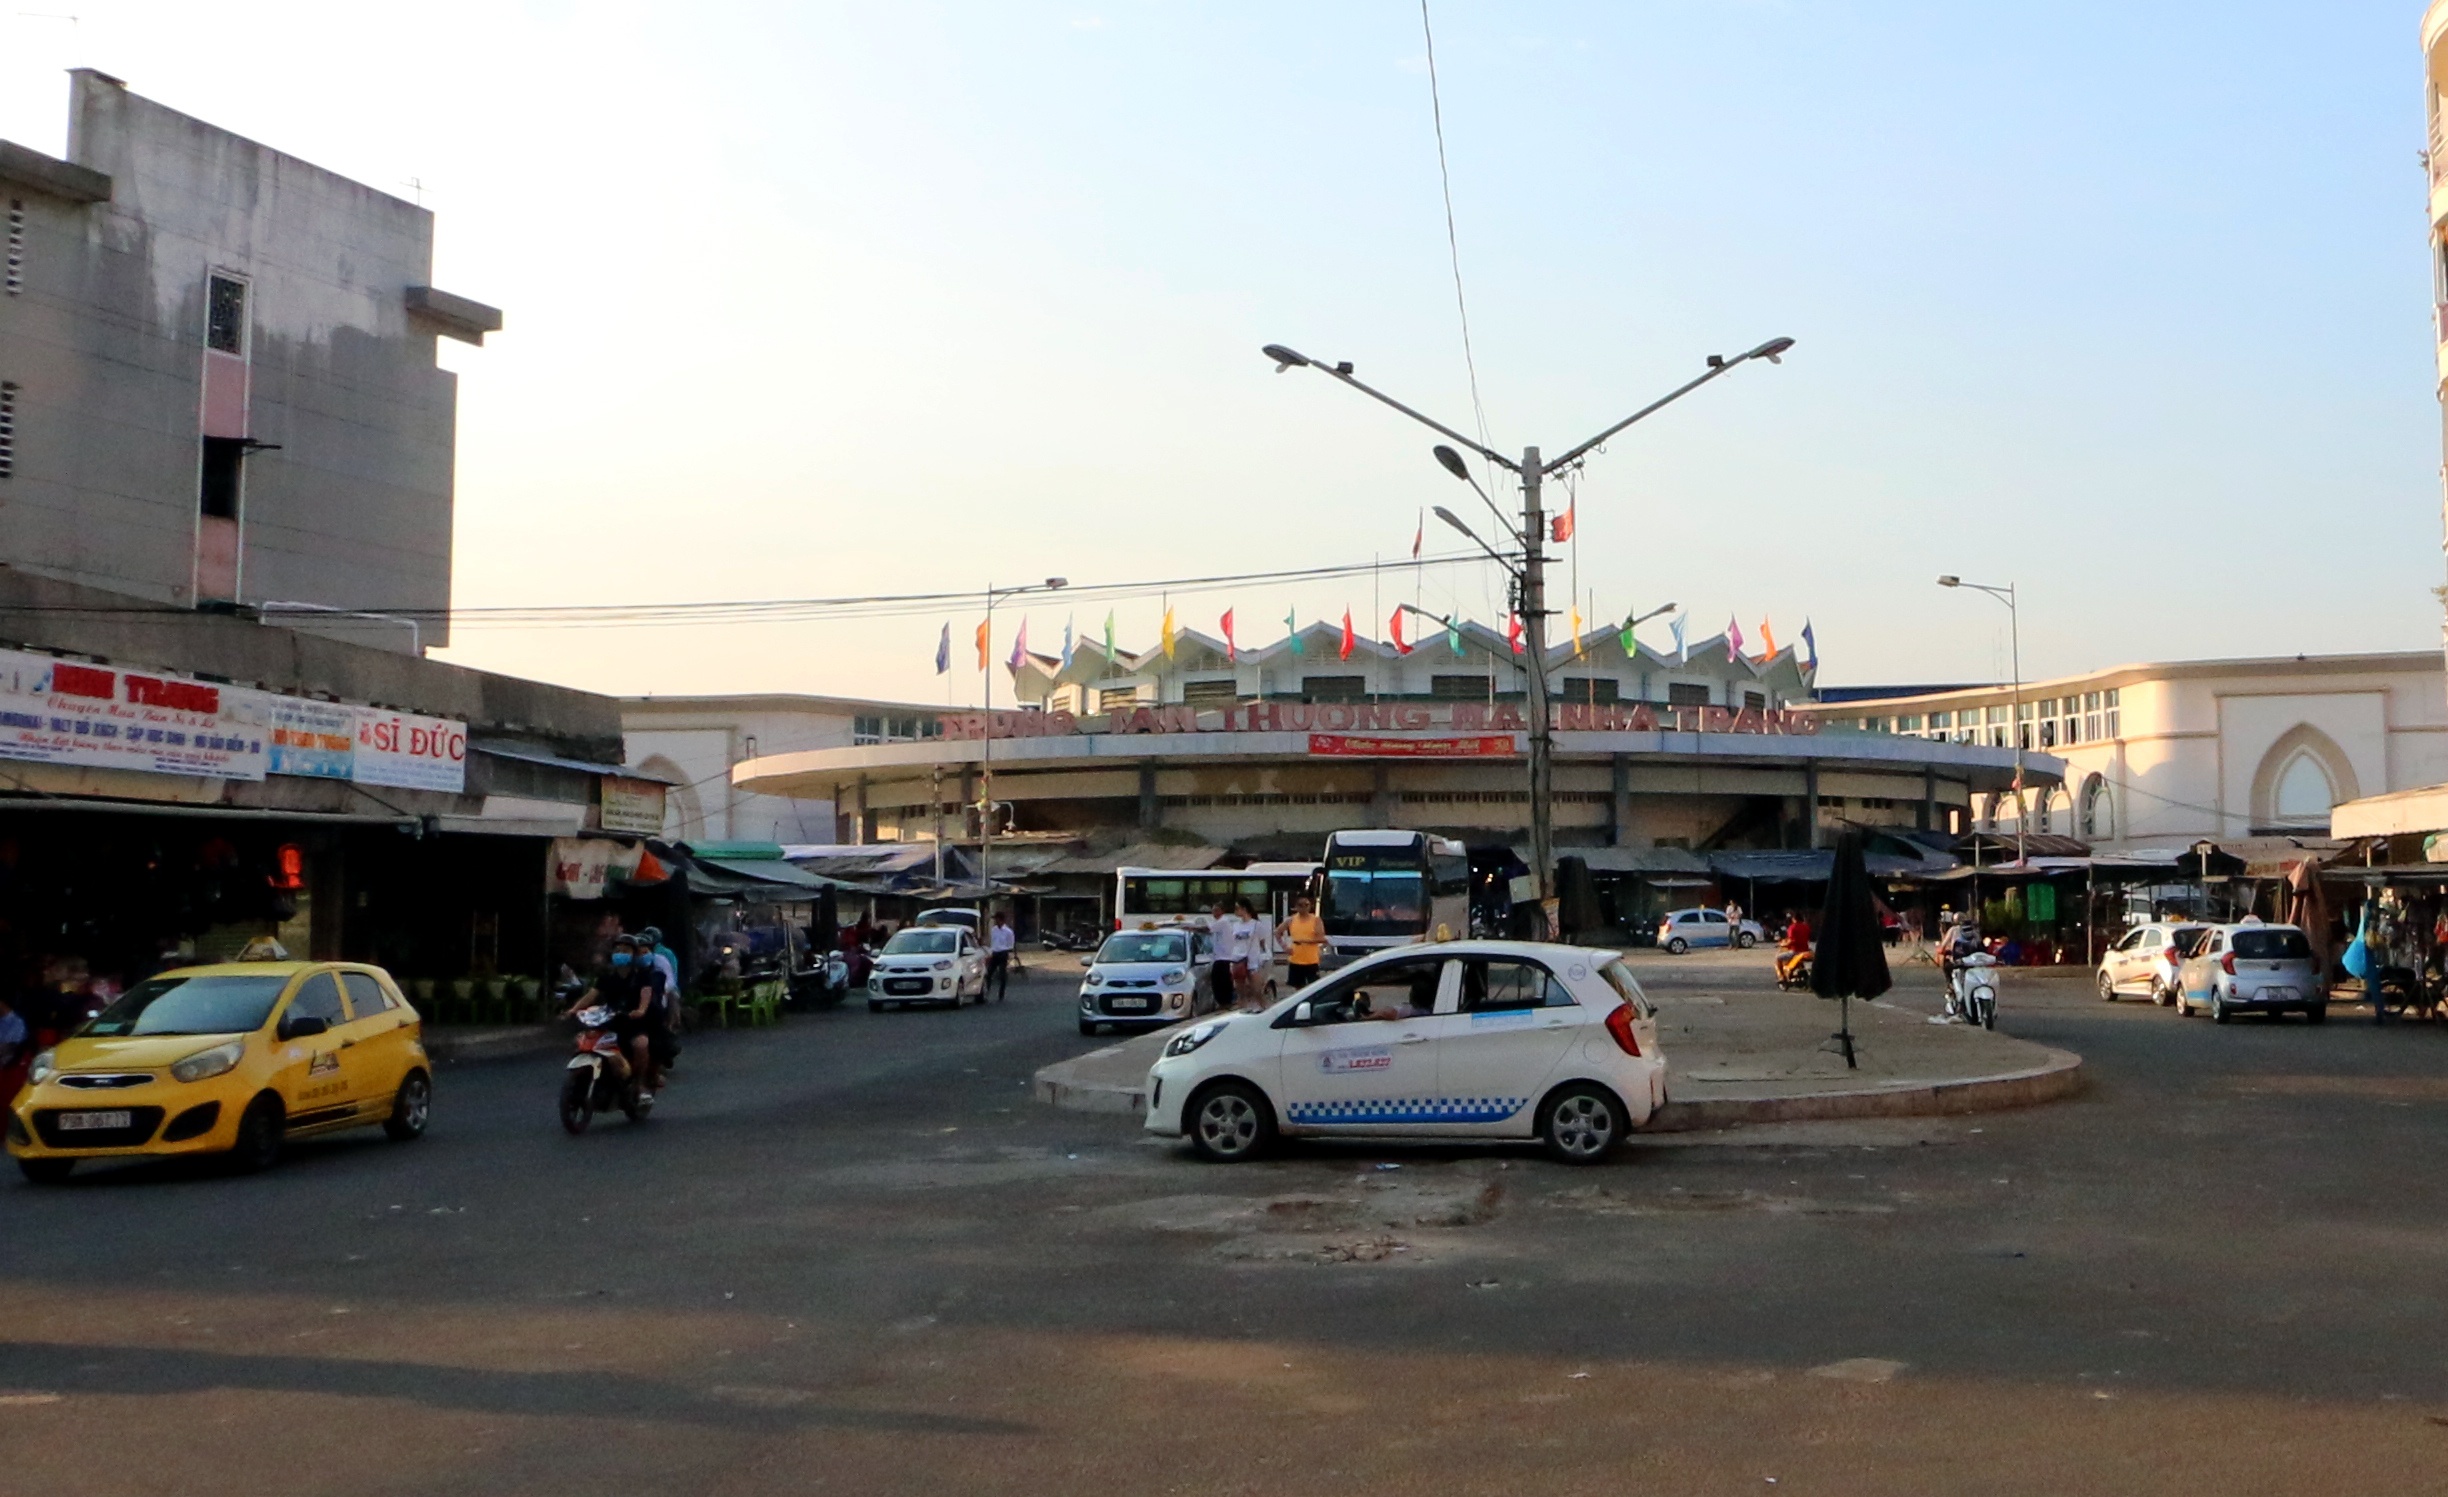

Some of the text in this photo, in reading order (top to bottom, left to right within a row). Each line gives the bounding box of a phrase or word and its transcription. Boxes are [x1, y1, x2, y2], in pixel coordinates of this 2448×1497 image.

[1557, 703, 1661, 732] NHA
[1667, 704, 1822, 736] TRANG
[408, 723, 466, 761] ĐỨC
[1336, 856, 1366, 868] VIP
